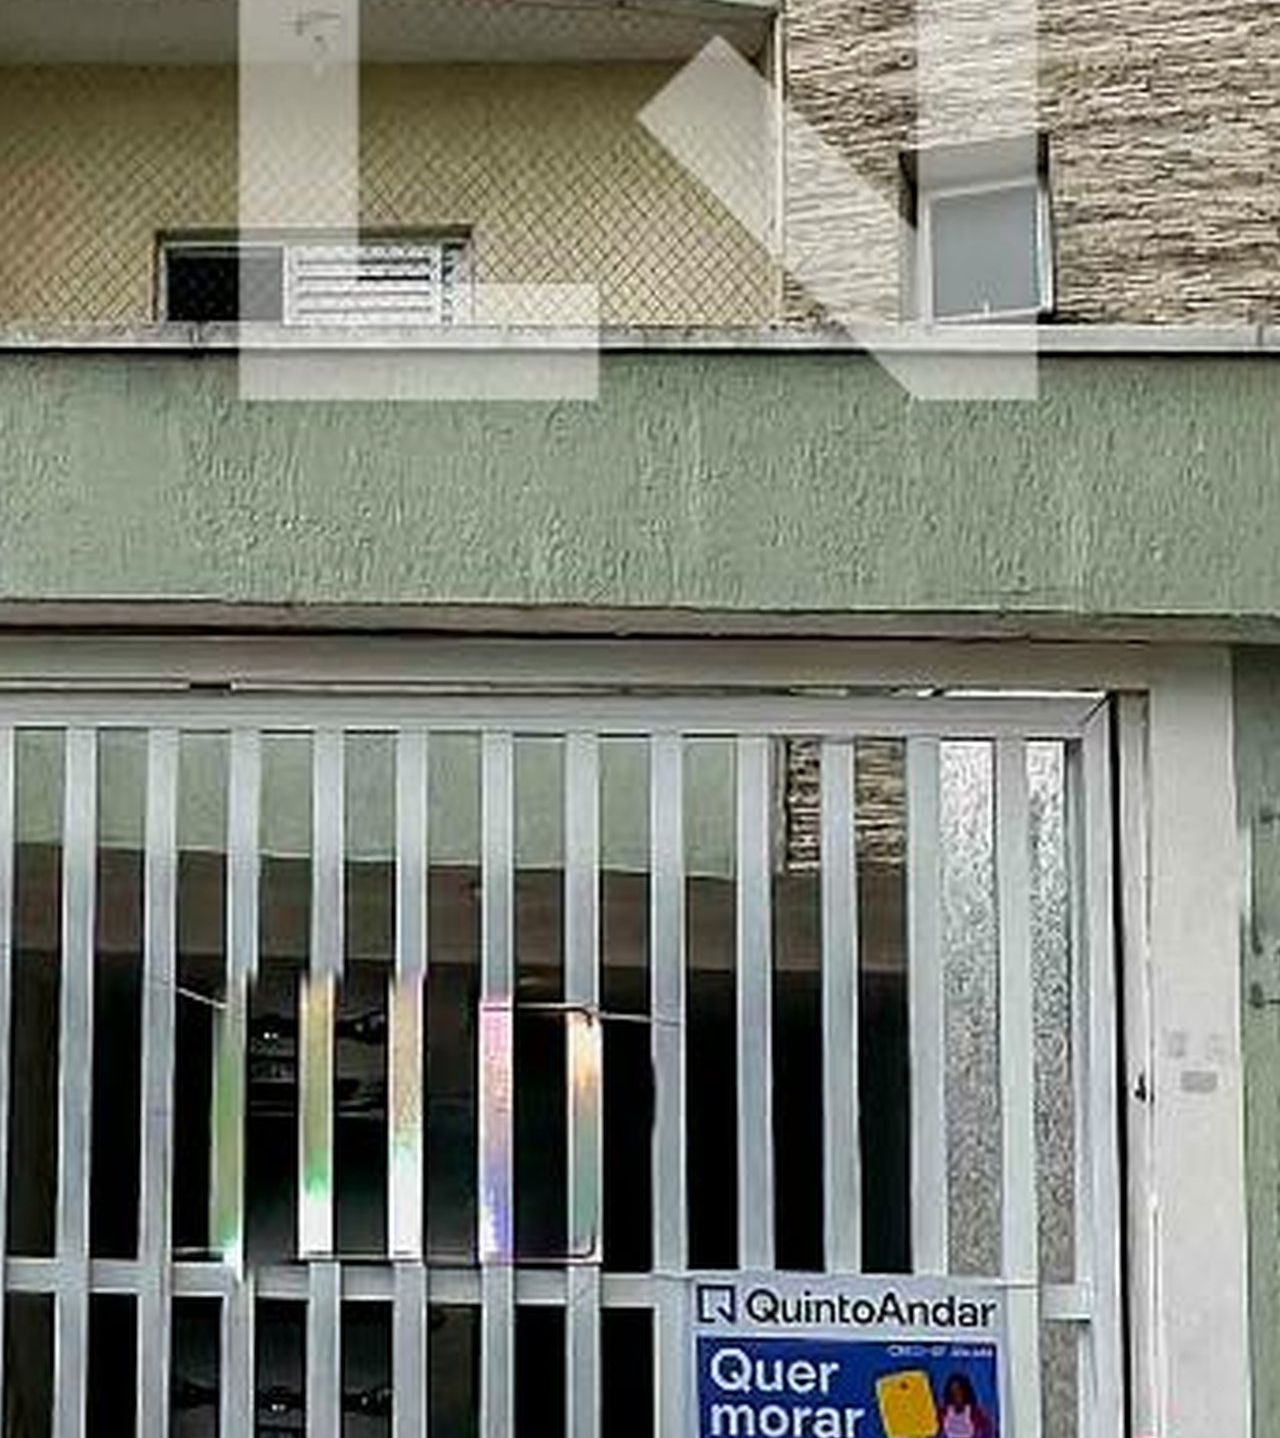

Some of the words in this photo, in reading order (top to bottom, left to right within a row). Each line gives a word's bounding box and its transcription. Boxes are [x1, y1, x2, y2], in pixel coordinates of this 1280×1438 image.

[746, 1288, 997, 1327] QuintoAndar
[711, 1348, 840, 1394] Quer
[711, 1404, 866, 1438] morar
